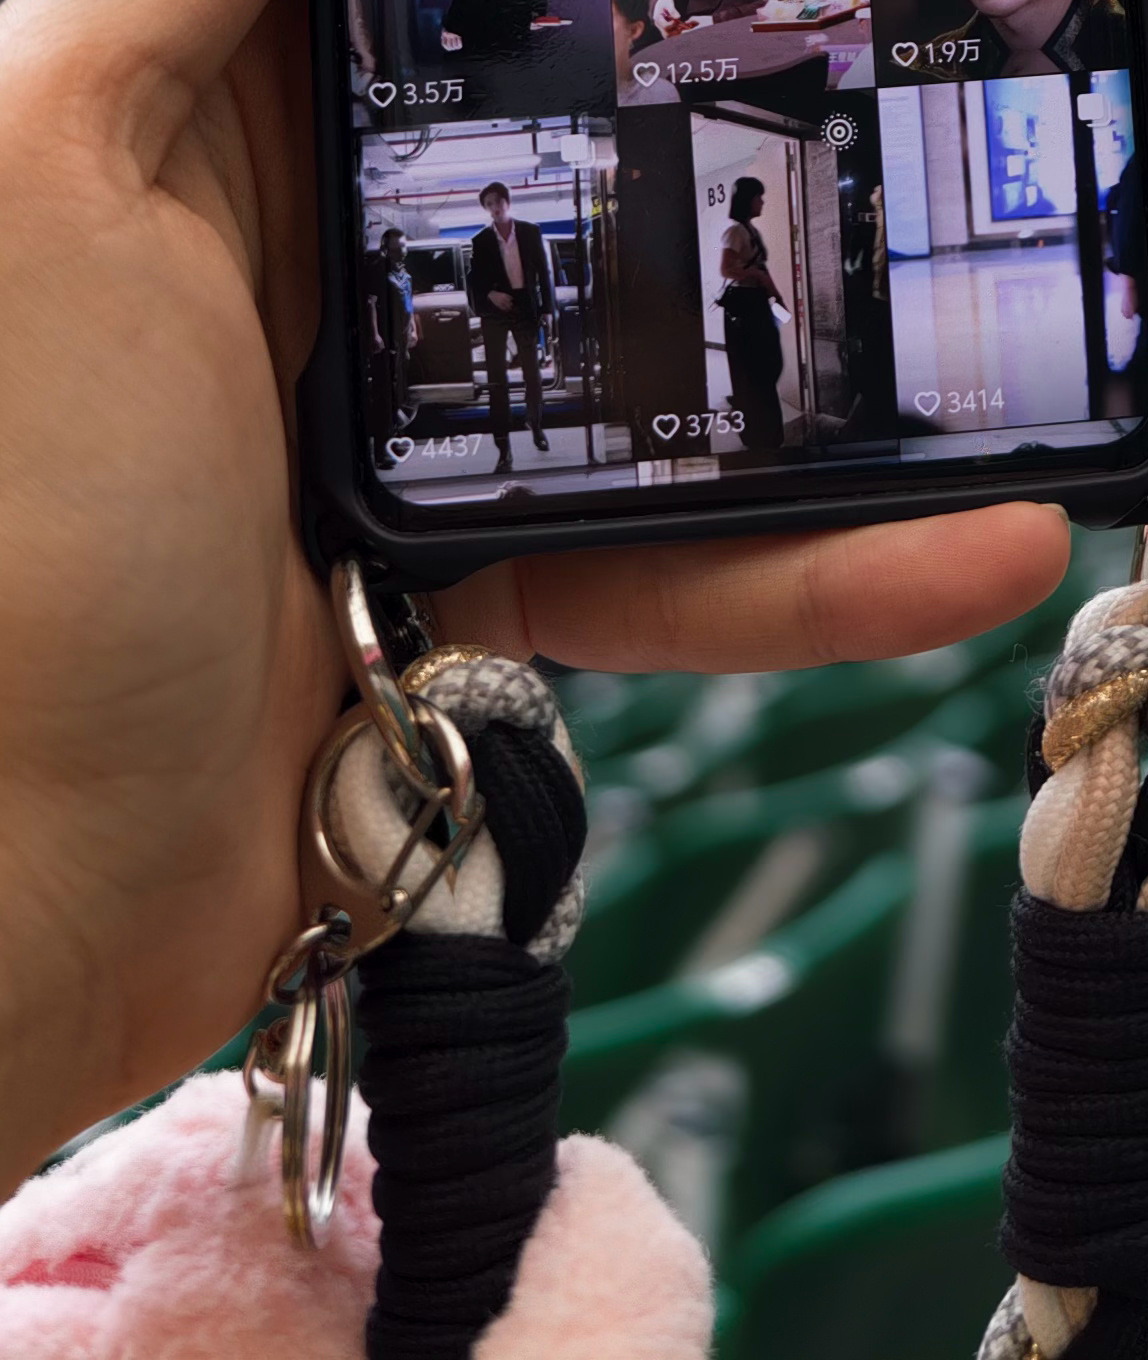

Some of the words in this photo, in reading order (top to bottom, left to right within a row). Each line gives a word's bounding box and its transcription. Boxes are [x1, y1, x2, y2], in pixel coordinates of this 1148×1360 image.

[924, 38, 982, 66] 1.9万
[665, 56, 740, 86] 12.5万
[402, 78, 465, 106] 3.5万
[707, 183, 726, 207] B3
[946, 389, 1006, 414] 3414
[686, 412, 746, 437] 3753
[420, 434, 483, 460] 4437
